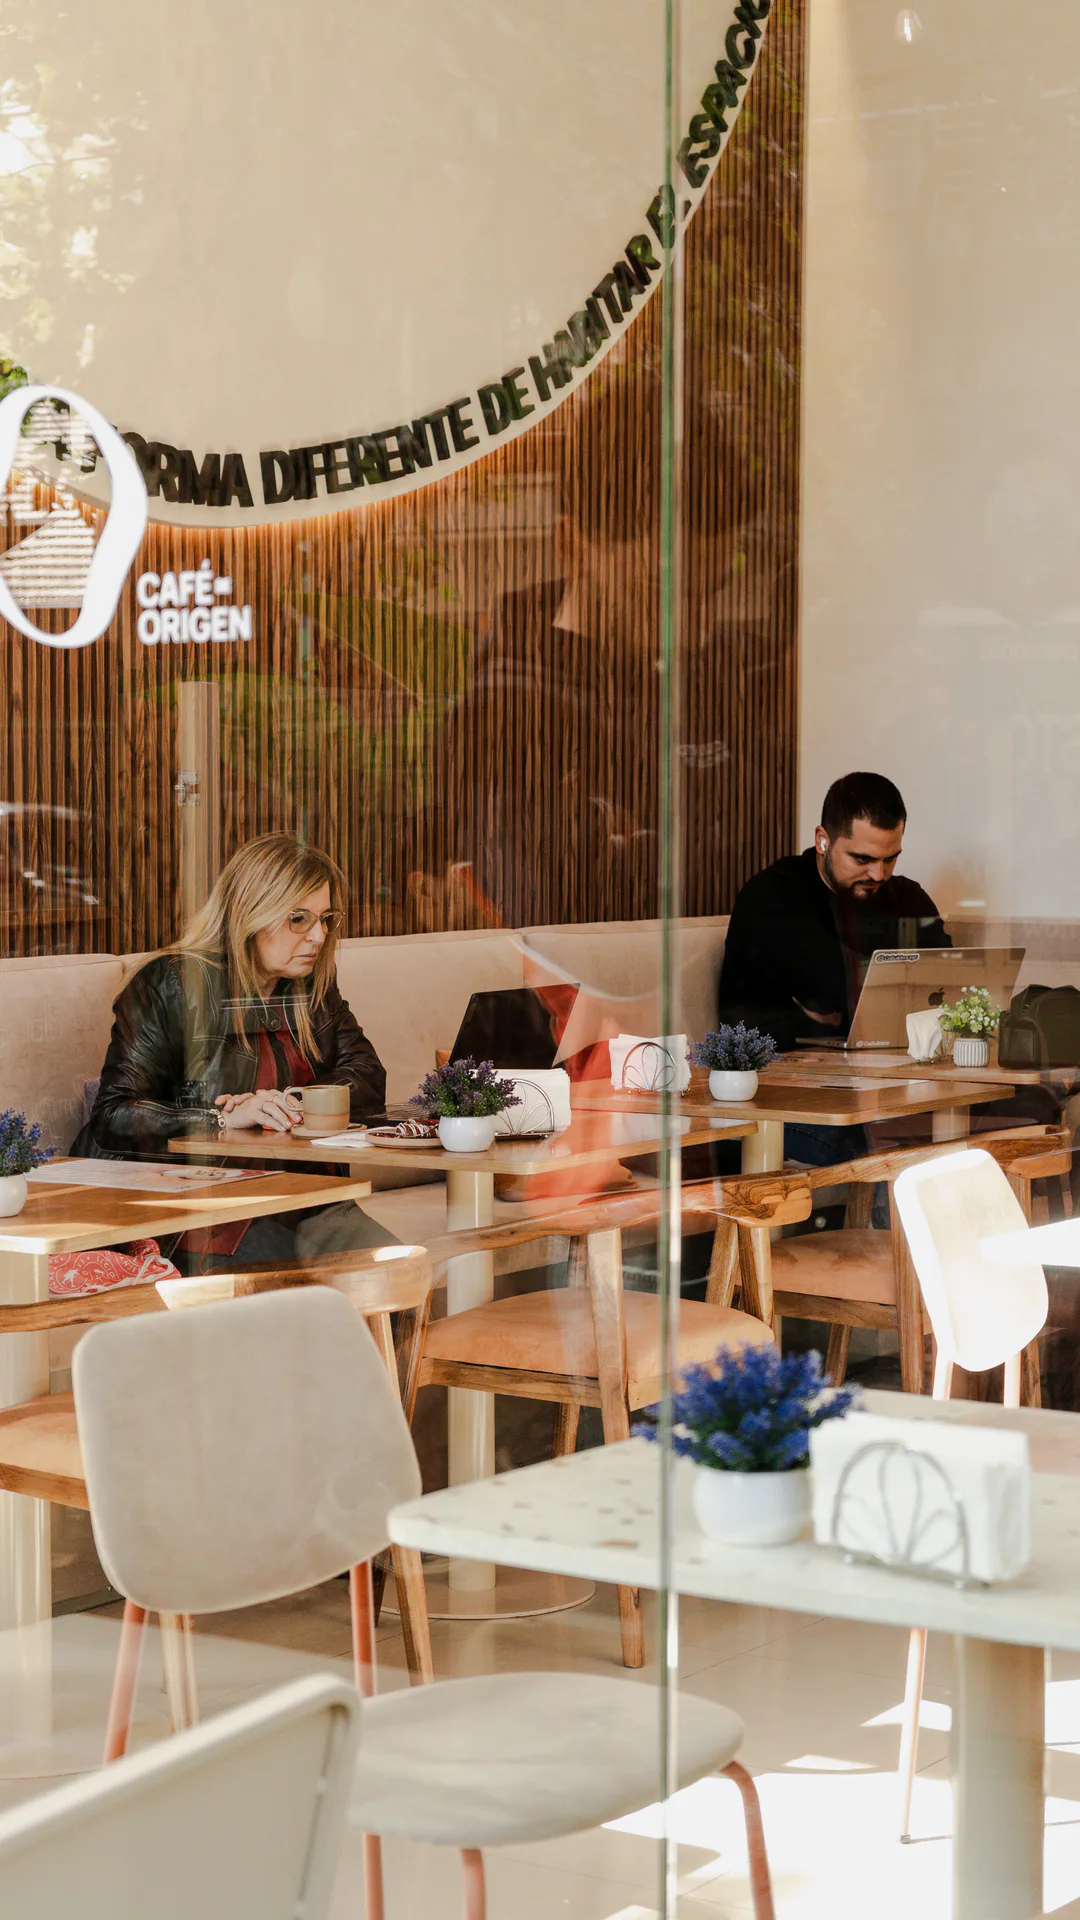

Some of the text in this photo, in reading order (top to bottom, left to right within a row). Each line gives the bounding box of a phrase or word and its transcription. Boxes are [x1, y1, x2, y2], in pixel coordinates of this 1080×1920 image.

[80, 424, 254, 507] ORMA
[259, 397, 480, 505] DIFERENTE
[477, 366, 535, 436] DE
[528, 234, 662, 402] HABITAR
[137, 558, 214, 608] CAFÉ
[137, 604, 252, 646] ORIGEN
